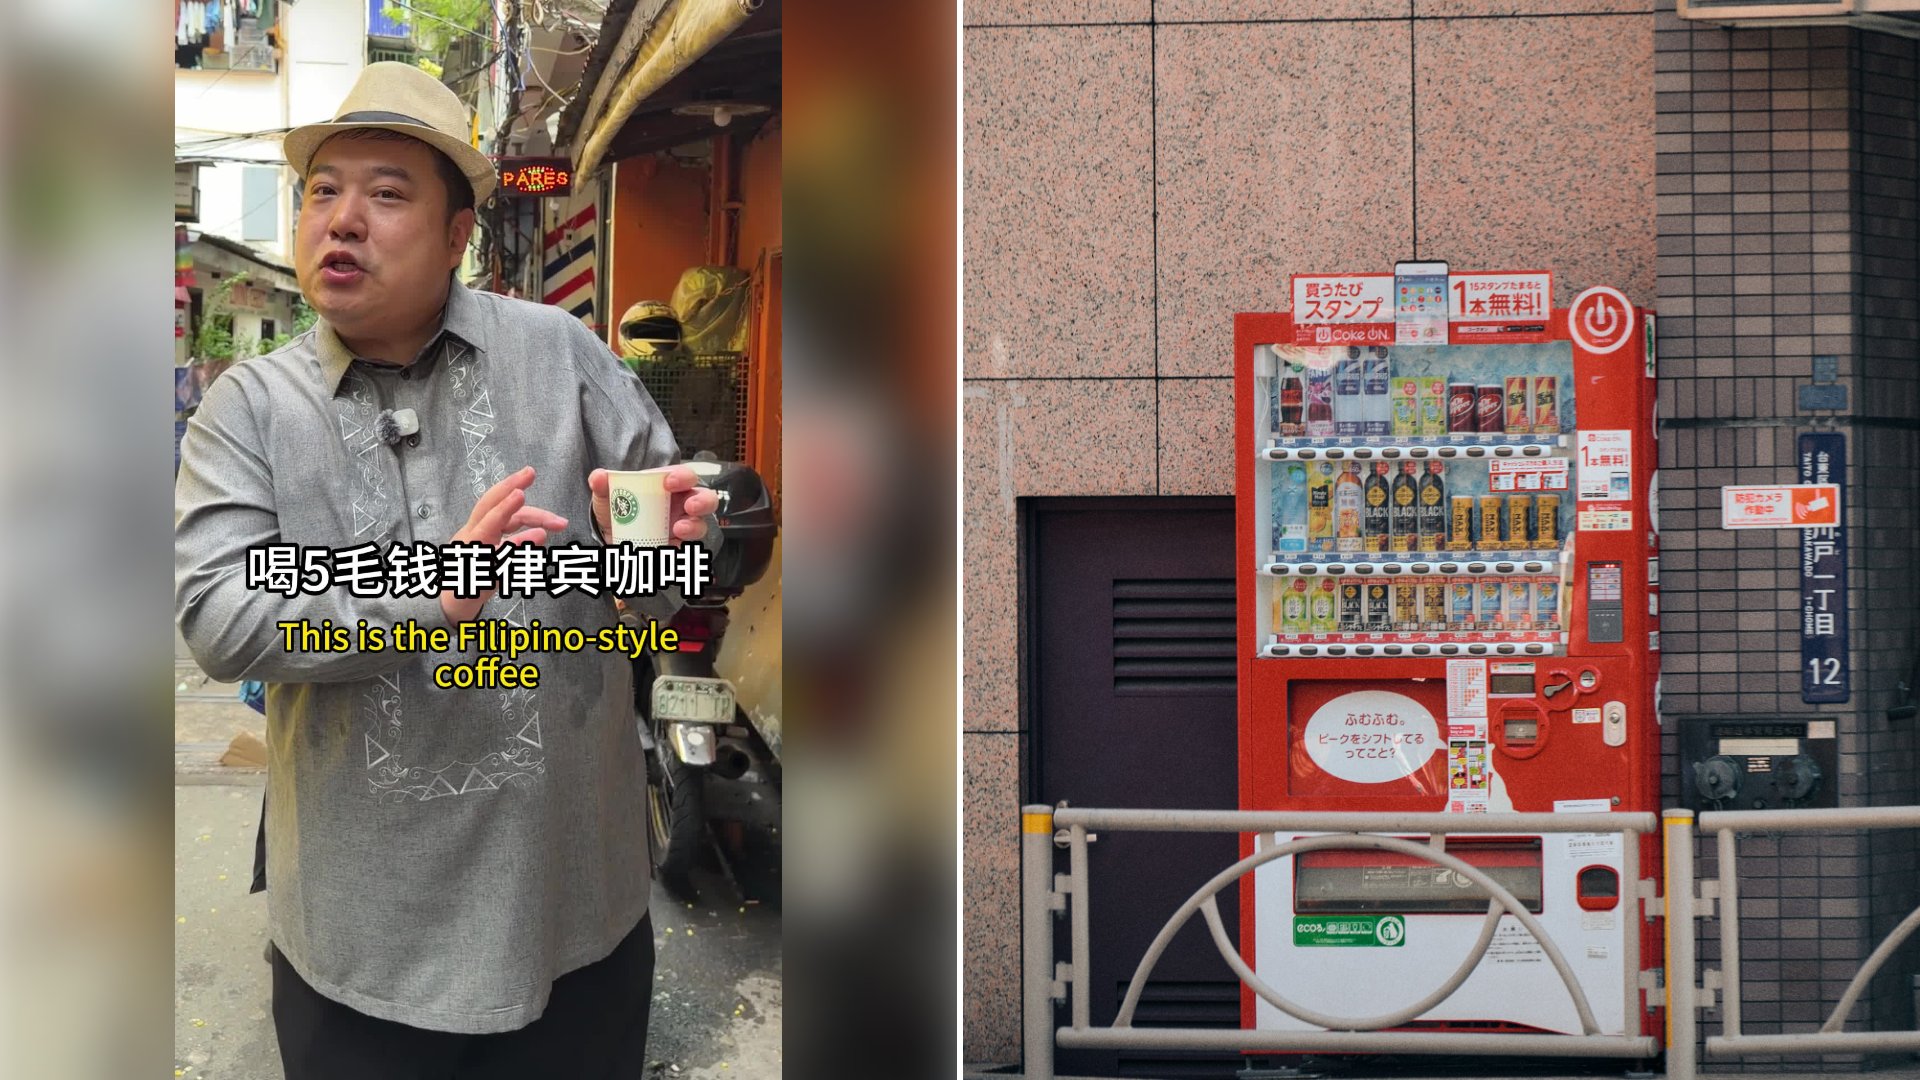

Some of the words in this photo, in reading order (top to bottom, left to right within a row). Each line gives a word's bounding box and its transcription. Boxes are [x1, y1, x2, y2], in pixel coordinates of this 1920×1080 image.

[503, 171, 568, 186] PARES
[1305, 281, 1363, 298] 買うたび
[1470, 281, 1542, 291] 15スタンプたまると
[1305, 297, 1383, 319] スタンプ
[1332, 329, 1366, 341] Coke
[1803, 452, 1812, 477] TAITO
[1365, 507, 1389, 518] BLACK
[1393, 506, 1418, 517] BLACK
[1420, 505, 1444, 517] BLACK
[1744, 505, 1775, 515] 作動中
[1804, 596, 1814, 635] 1-CHOME
[1809, 657, 1841, 685] 12
[1345, 713, 1405, 726] ふむふむ。
[1345, 747, 1396, 759] ってこと?
